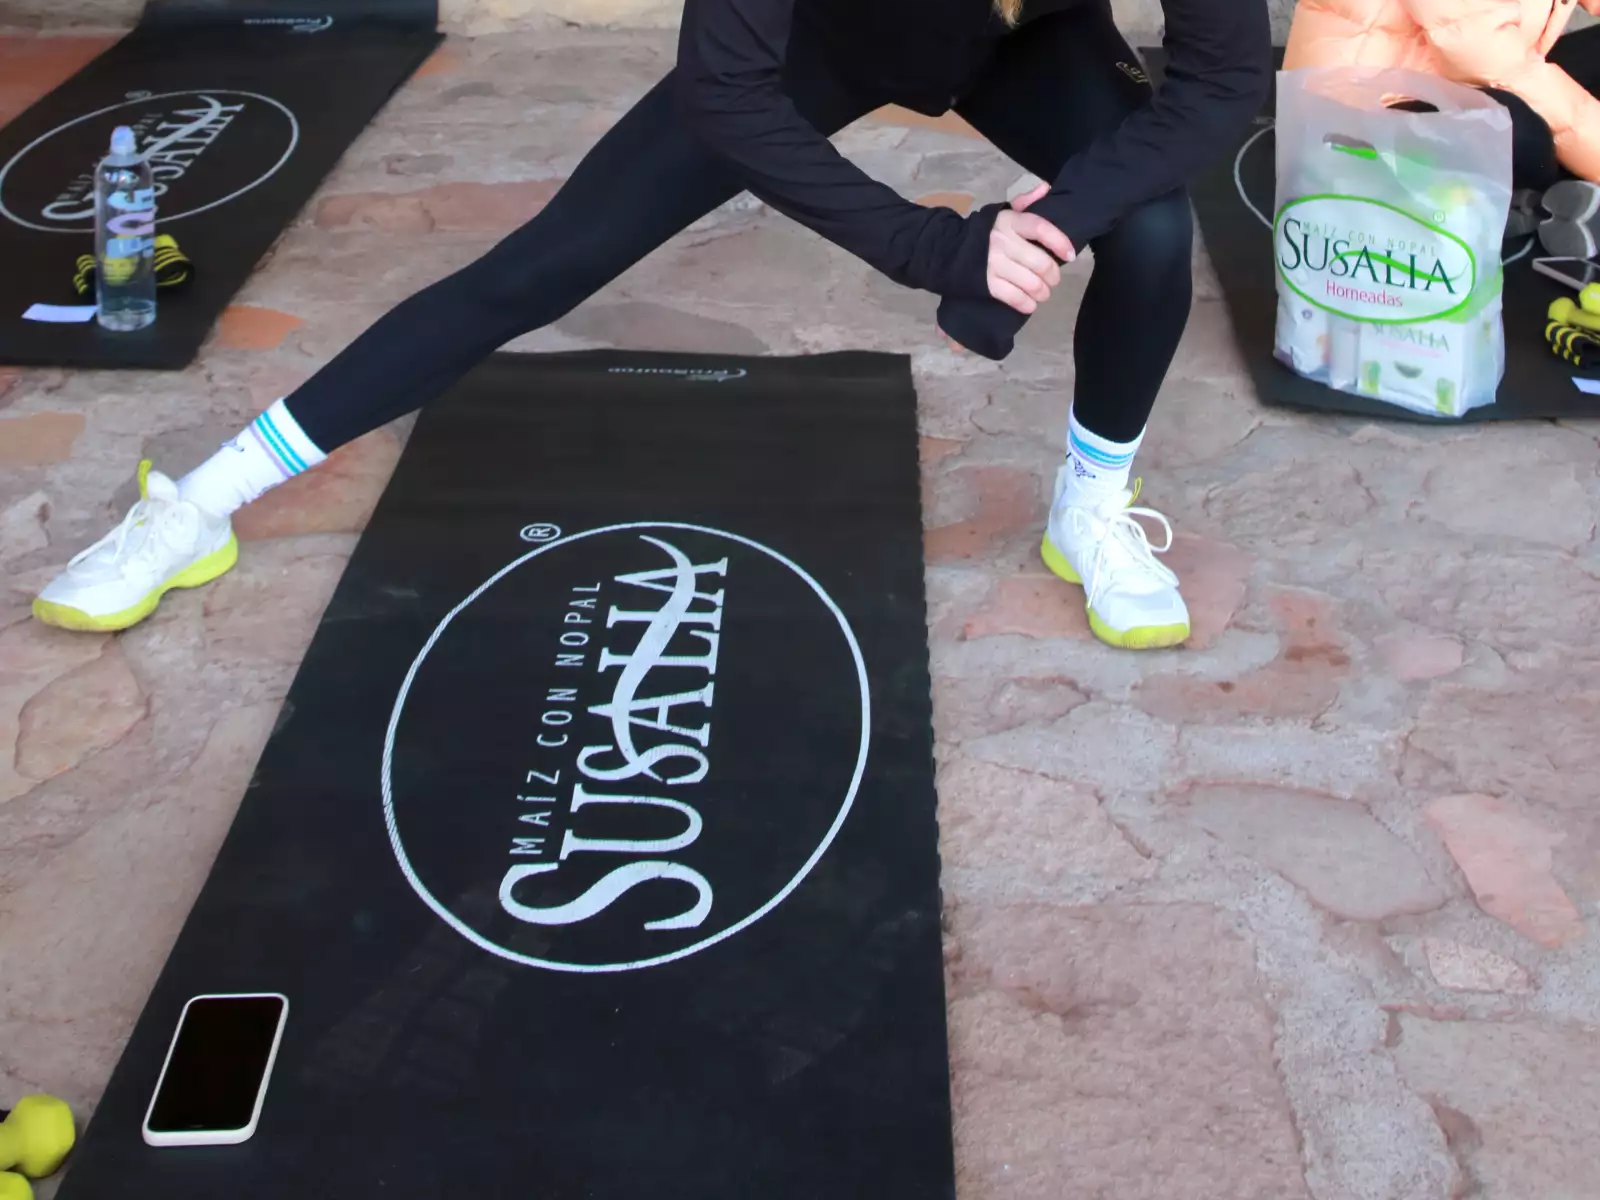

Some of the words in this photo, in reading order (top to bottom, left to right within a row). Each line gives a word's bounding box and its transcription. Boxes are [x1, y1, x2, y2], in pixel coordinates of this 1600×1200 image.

[1281, 217, 1458, 295] SUSALIA
[1348, 230, 1376, 246] CON
[1387, 238, 1437, 258] NOPAL
[1325, 279, 1404, 308] Horneadas
[554, 581, 601, 667] NOPAL
[498, 534, 729, 931] SUSALIA
[536, 688, 578, 747] CON
[508, 769, 562, 855] MAÍZ
